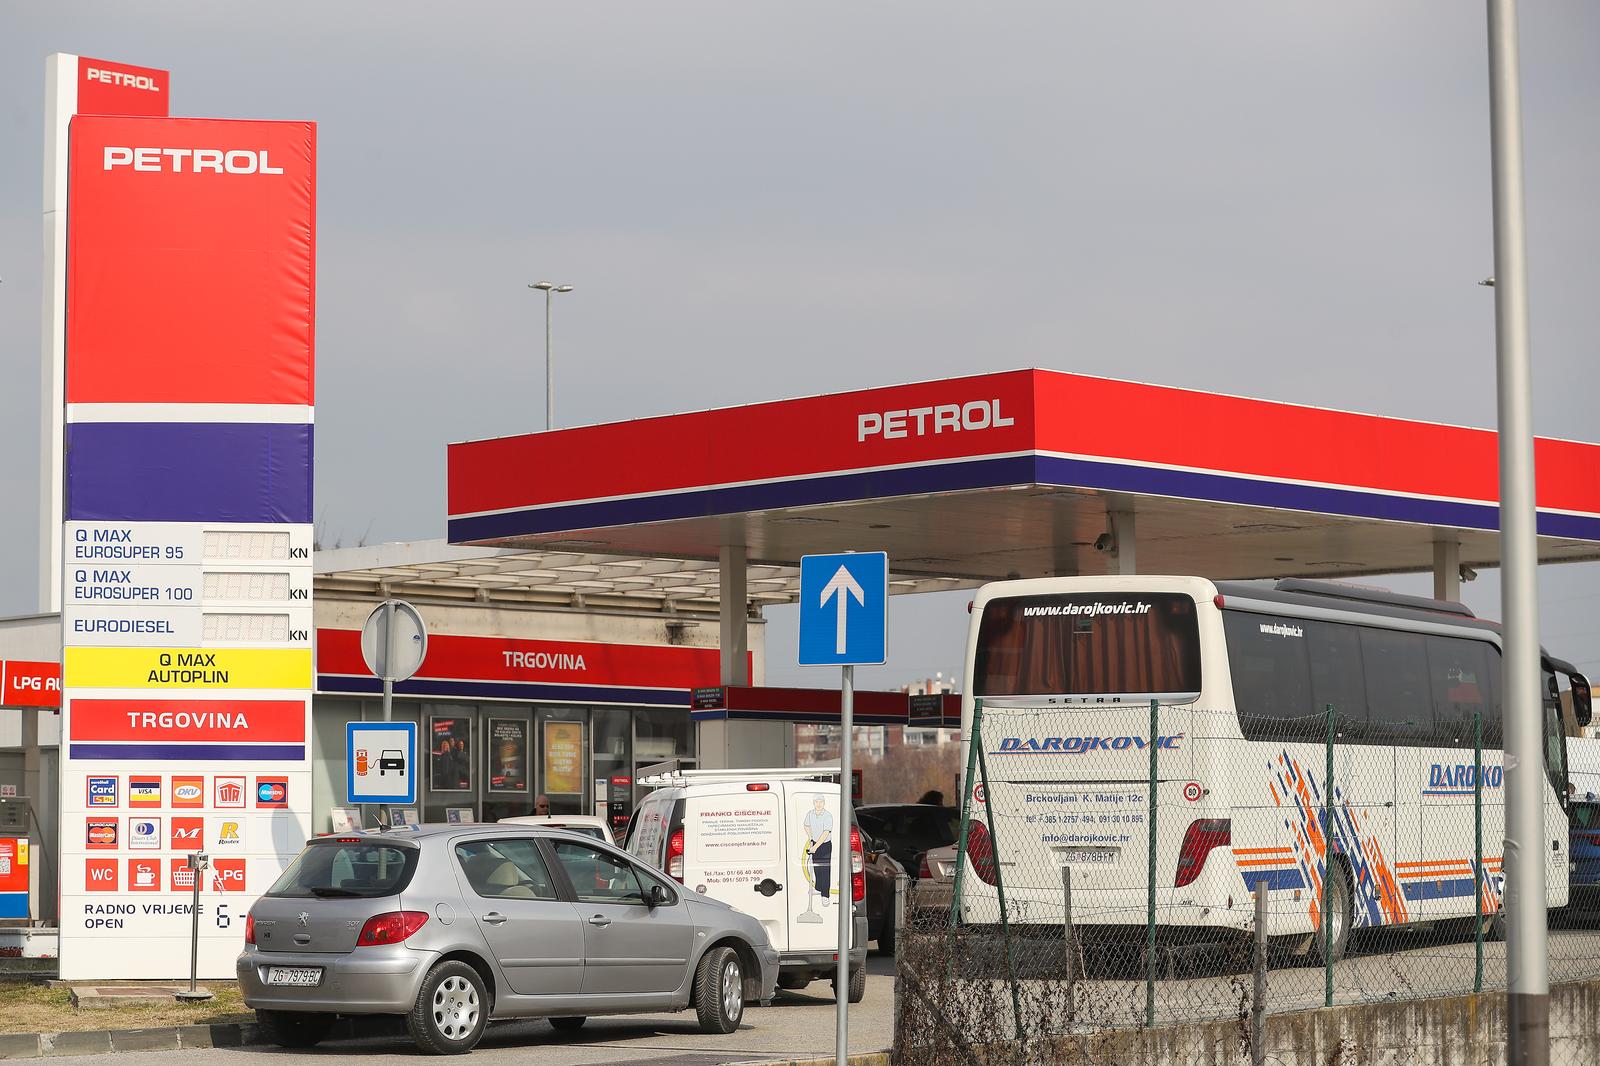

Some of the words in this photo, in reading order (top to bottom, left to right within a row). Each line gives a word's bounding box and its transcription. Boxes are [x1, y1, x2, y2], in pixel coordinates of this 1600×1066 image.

[88, 67, 159, 92] PETROL
[103, 146, 284, 175] PETROL
[857, 398, 1015, 442] PETROL
[75, 529, 88, 543] Q
[93, 529, 132, 543] MAX
[75, 545, 160, 559] EUROSUPER
[165, 546, 184, 559] 95
[289, 548, 308, 559] KN
[75, 569, 87, 583] Q
[93, 570, 131, 583] MAX
[74, 586, 159, 600] EUROSUPER
[165, 587, 193, 600] 100
[289, 588, 308, 600] KN
[1023, 601, 1152, 618] www.darojkovic.hr
[73, 619, 175, 633] EURODIESEL
[289, 630, 308, 641] KN
[159, 653, 172, 667] Q
[177, 653, 216, 667] MAX
[501, 650, 587, 671] TRGOVINA
[13, 675, 42, 690] LPG
[147, 670, 229, 683] AUTOPLIN
[127, 712, 249, 729] TRGOVINA
[90, 784, 115, 794] Card
[177, 788, 198, 796] DKV
[1188, 787, 1198, 796] 80
[1026, 794, 1077, 804] Brckovljani
[1095, 794, 1124, 804] Matije
[1127, 794, 1143, 803] 12c
[1041, 833, 1130, 844] info@darojkovic.hr
[90, 868, 114, 881] WC
[84, 903, 136, 915] RADNO
[142, 904, 204, 915] VRIJEME
[84, 918, 124, 929] OPEN
[216, 904, 230, 929] 6
[273, 969, 284, 982] ZG
